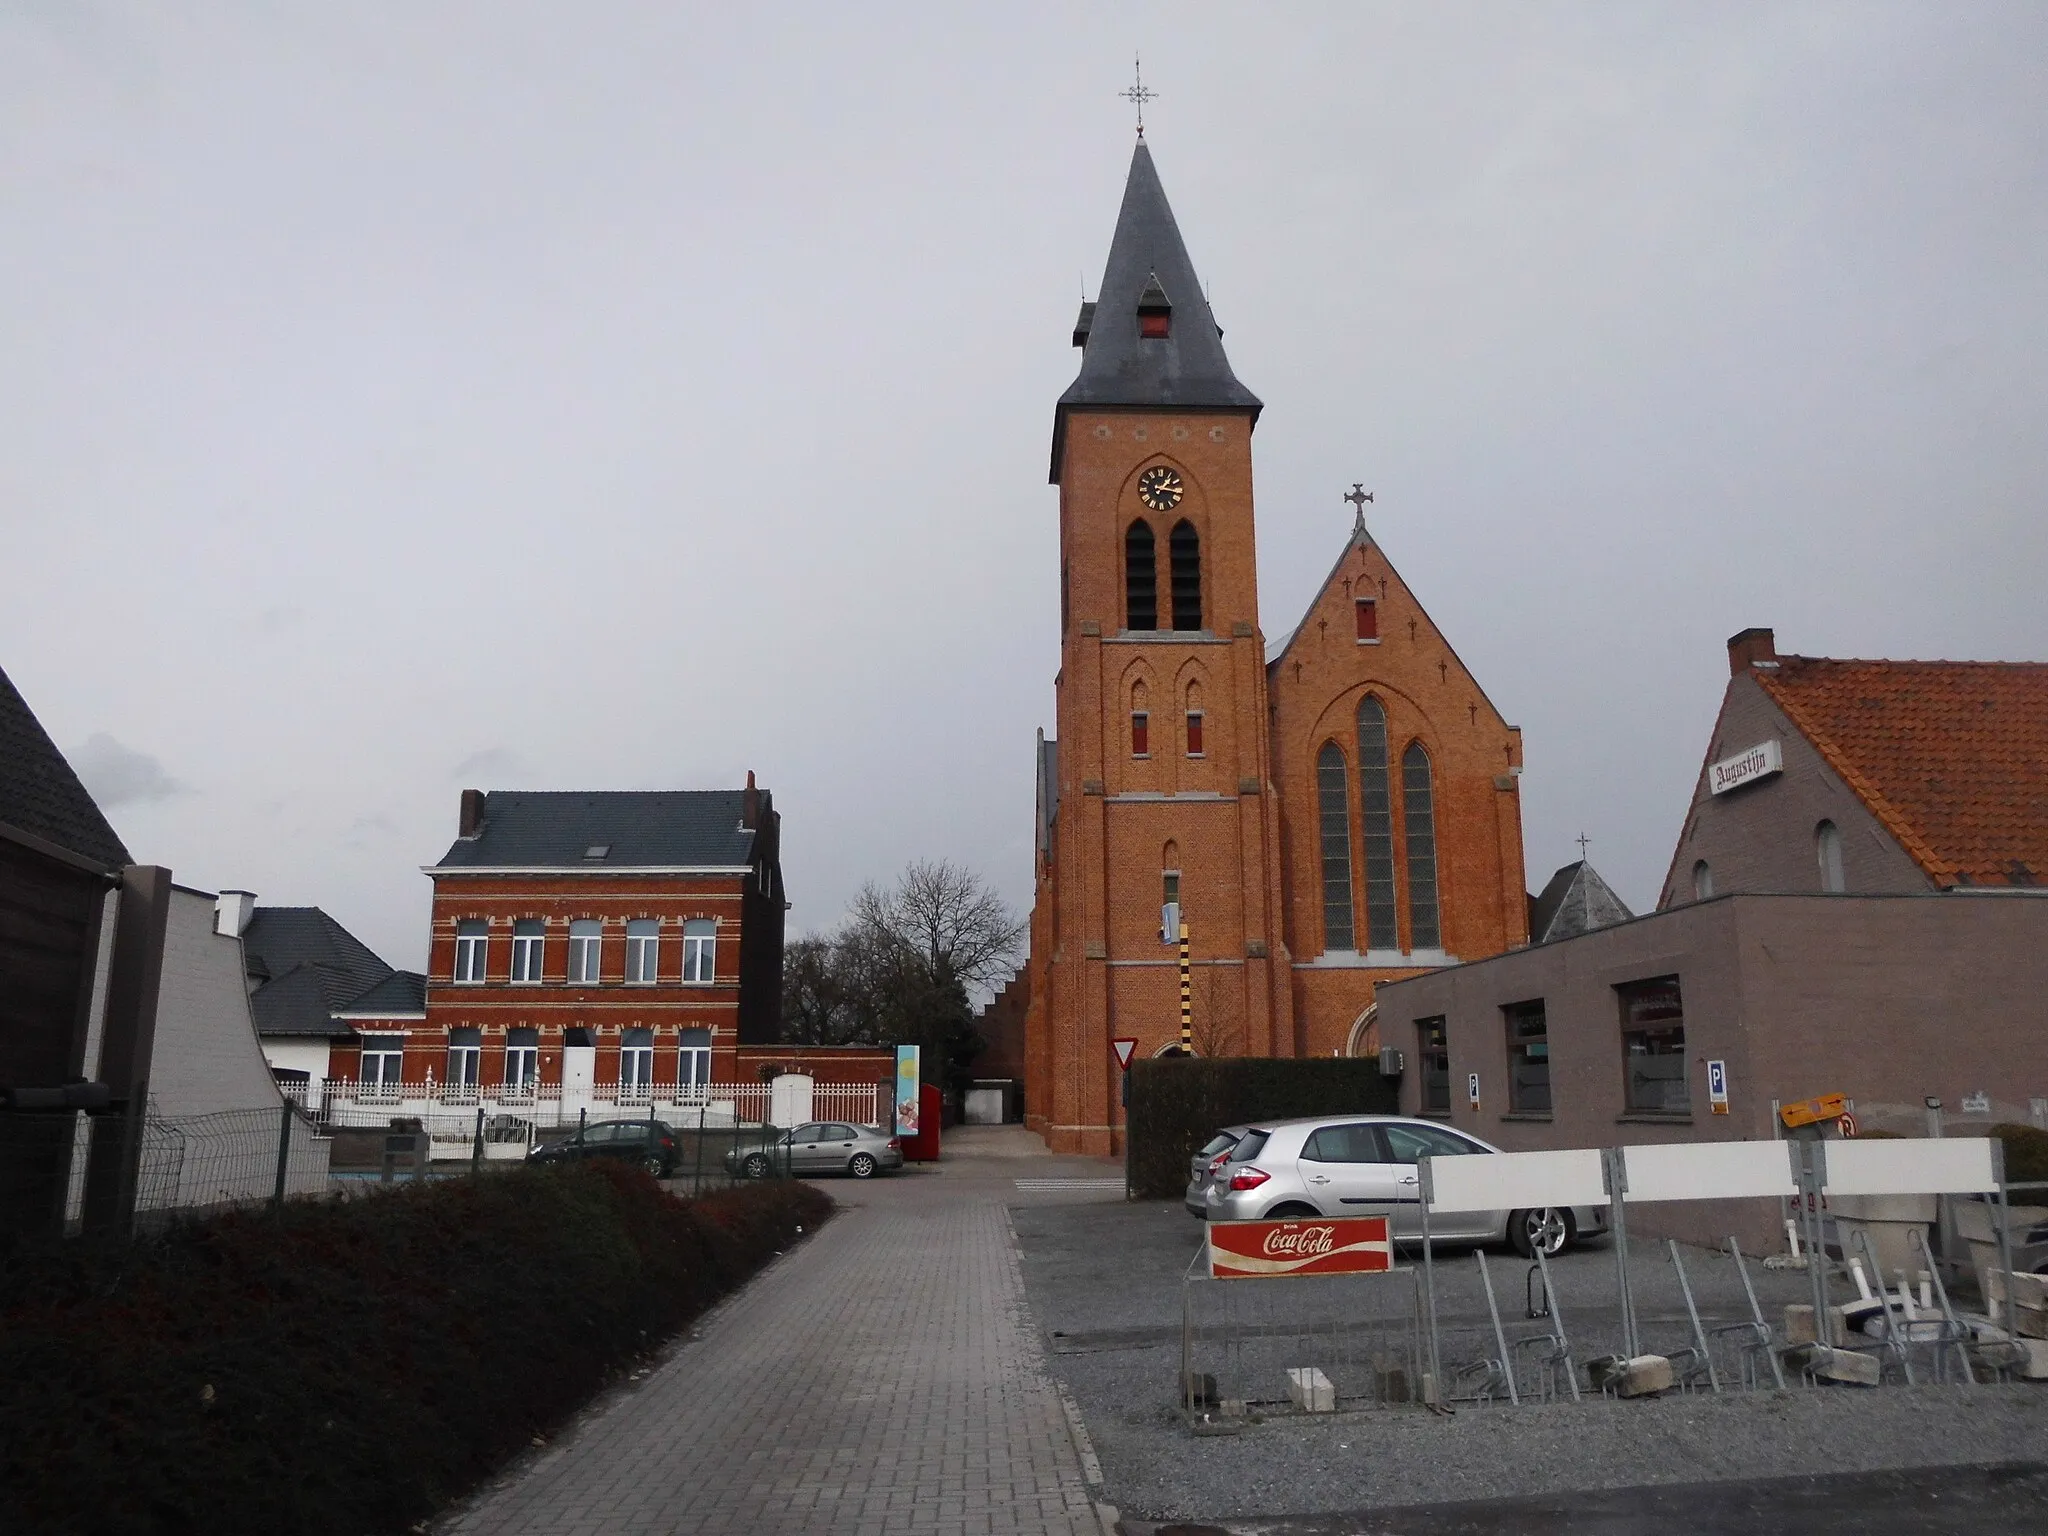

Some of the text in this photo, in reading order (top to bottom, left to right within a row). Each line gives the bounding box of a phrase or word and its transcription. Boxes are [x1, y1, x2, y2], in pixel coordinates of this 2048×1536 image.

[1716, 750, 1766, 790] Augustijn
[1712, 1068, 1721, 1086] P
[1263, 1226, 1335, 1255] Coca-Cola
